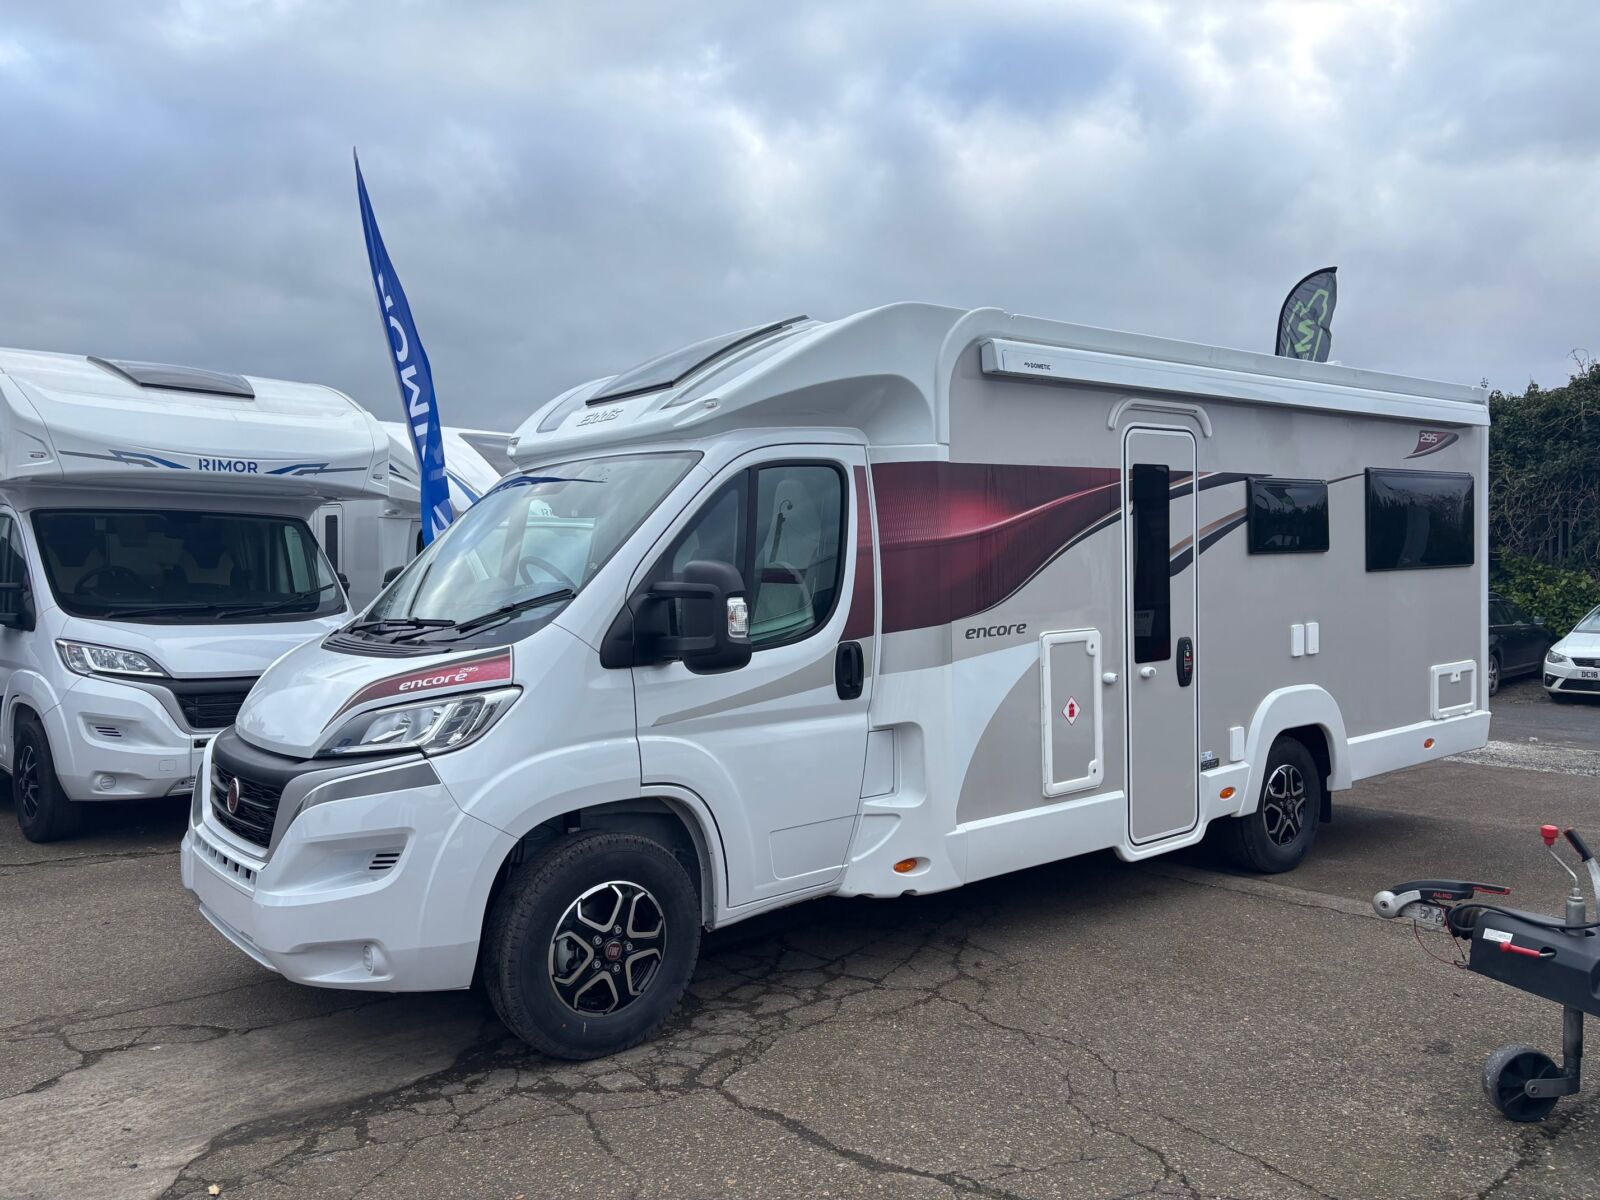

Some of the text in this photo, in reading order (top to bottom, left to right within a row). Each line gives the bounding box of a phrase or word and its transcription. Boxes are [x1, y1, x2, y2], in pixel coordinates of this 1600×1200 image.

[1420, 432, 1438, 443] 295
[198, 458, 258, 474] RIMOR
[964, 623, 1027, 640] encore
[398, 665, 479, 691] encore 295
